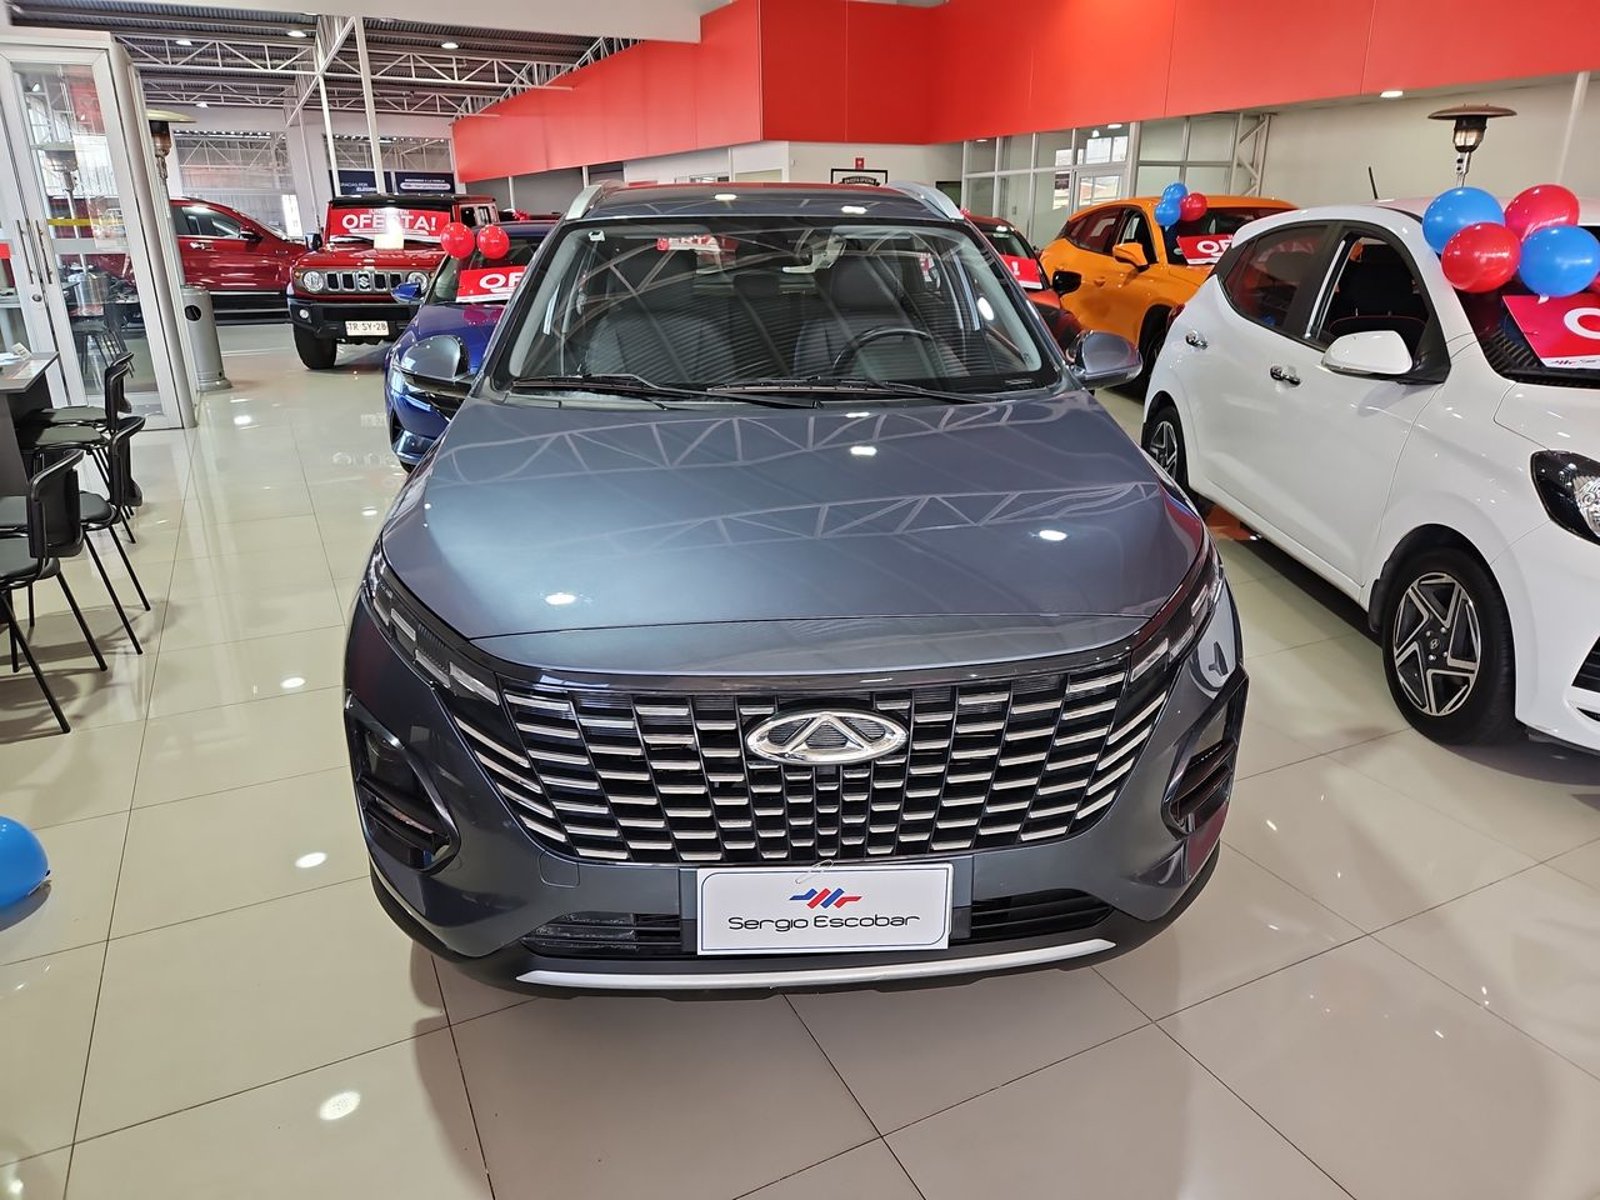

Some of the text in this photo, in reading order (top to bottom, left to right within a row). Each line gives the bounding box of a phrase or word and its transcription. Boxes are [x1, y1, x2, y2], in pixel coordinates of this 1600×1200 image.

[341, 214, 437, 231] OFETA!
[728, 913, 921, 932] Sergio Escobar
